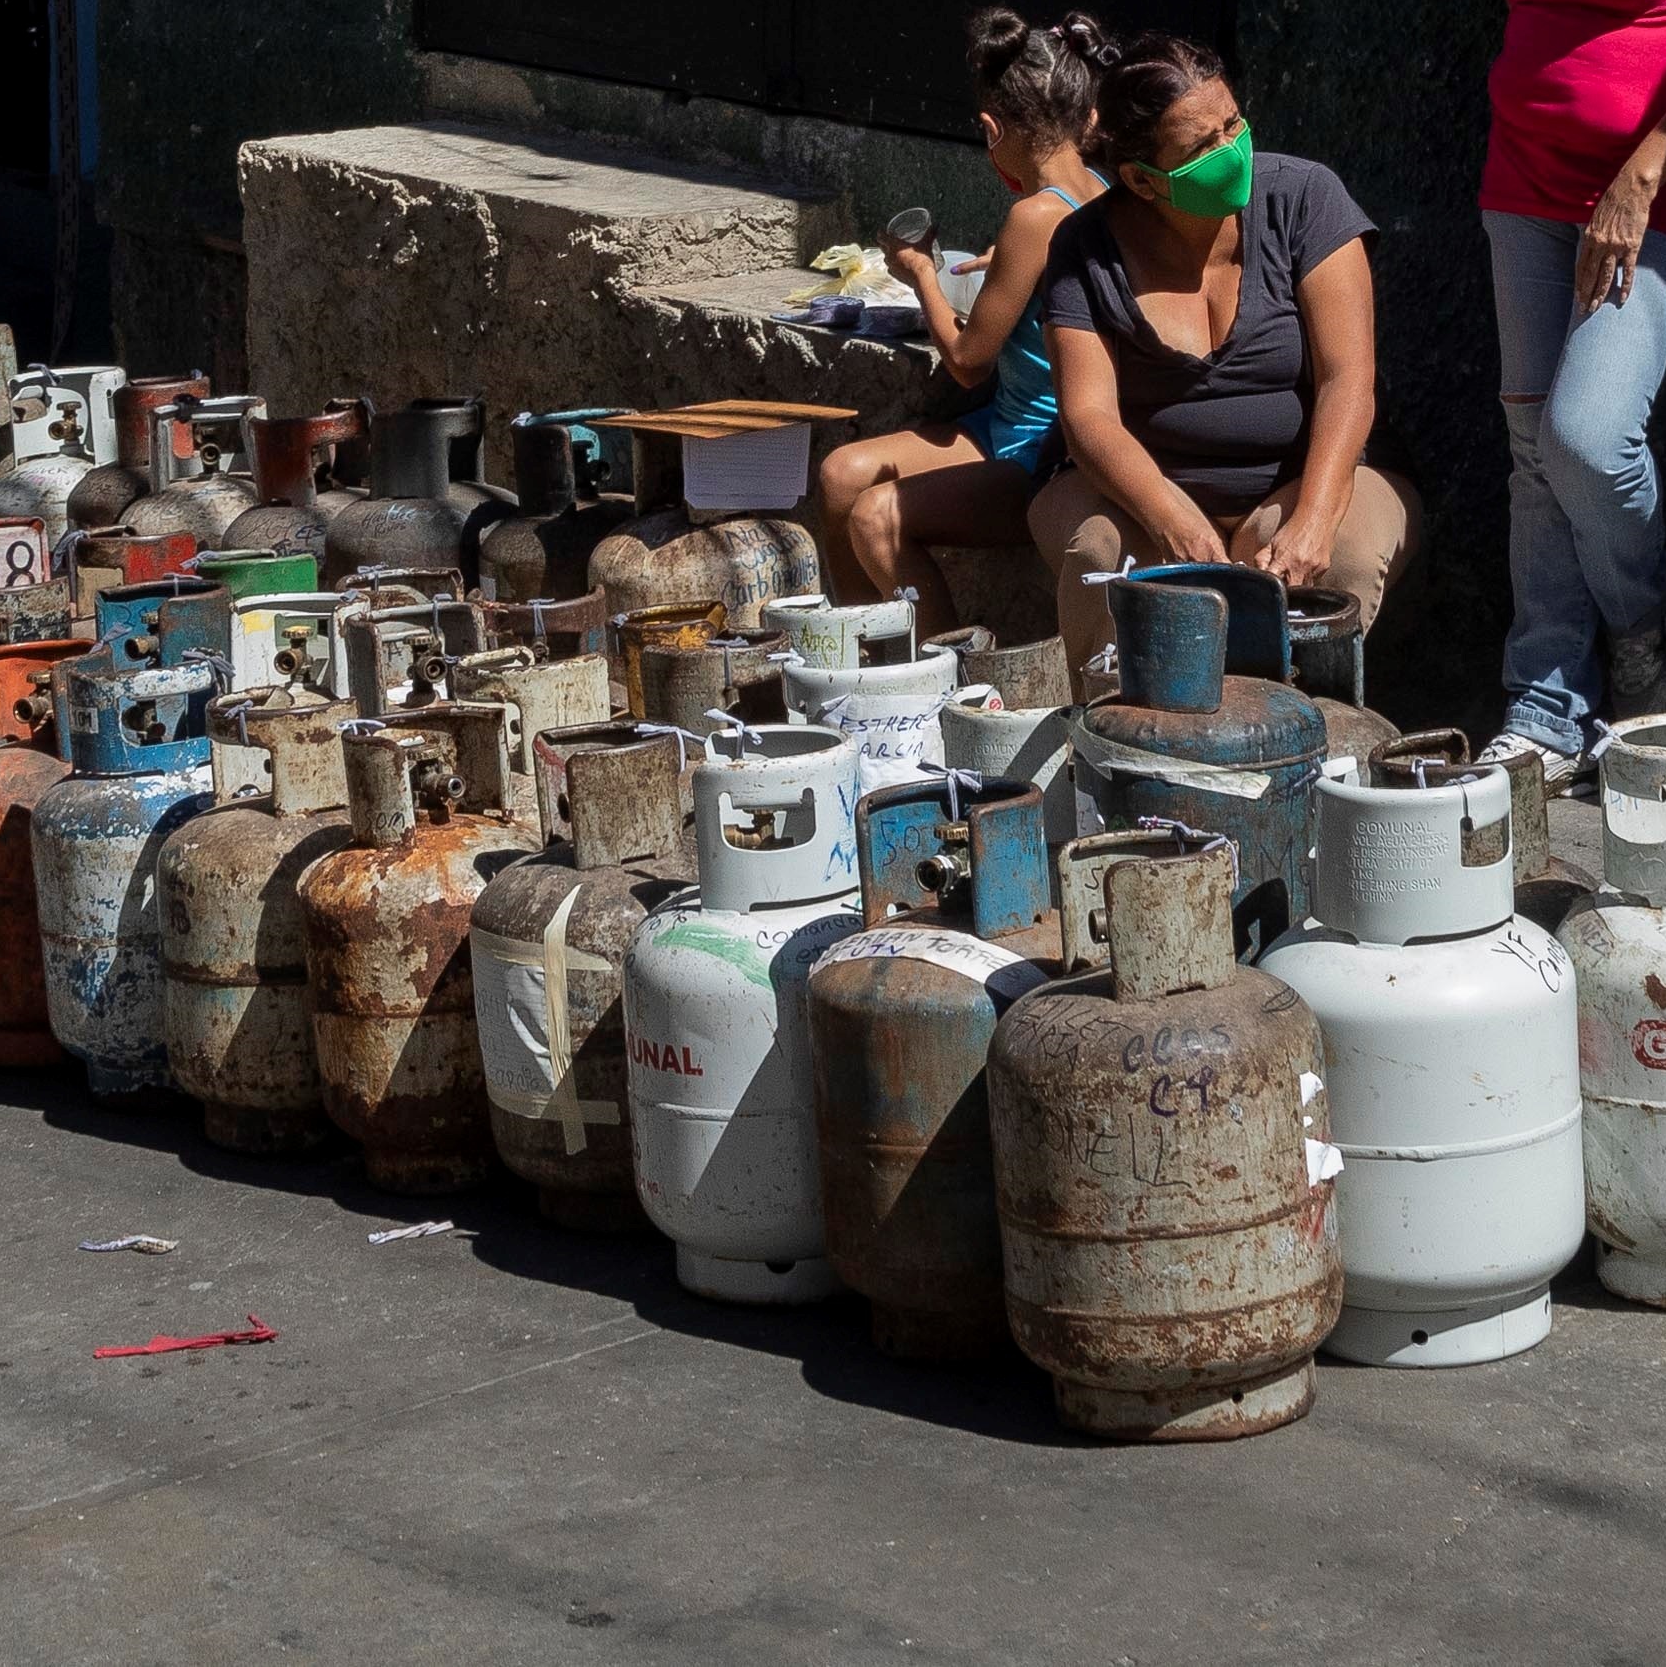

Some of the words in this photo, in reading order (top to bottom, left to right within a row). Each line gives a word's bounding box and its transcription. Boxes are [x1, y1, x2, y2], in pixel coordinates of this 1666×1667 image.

[839, 714, 925, 732] ESTHER
[858, 741, 924, 760] ARCIA
[1356, 820, 1434, 836] COMUNAL
